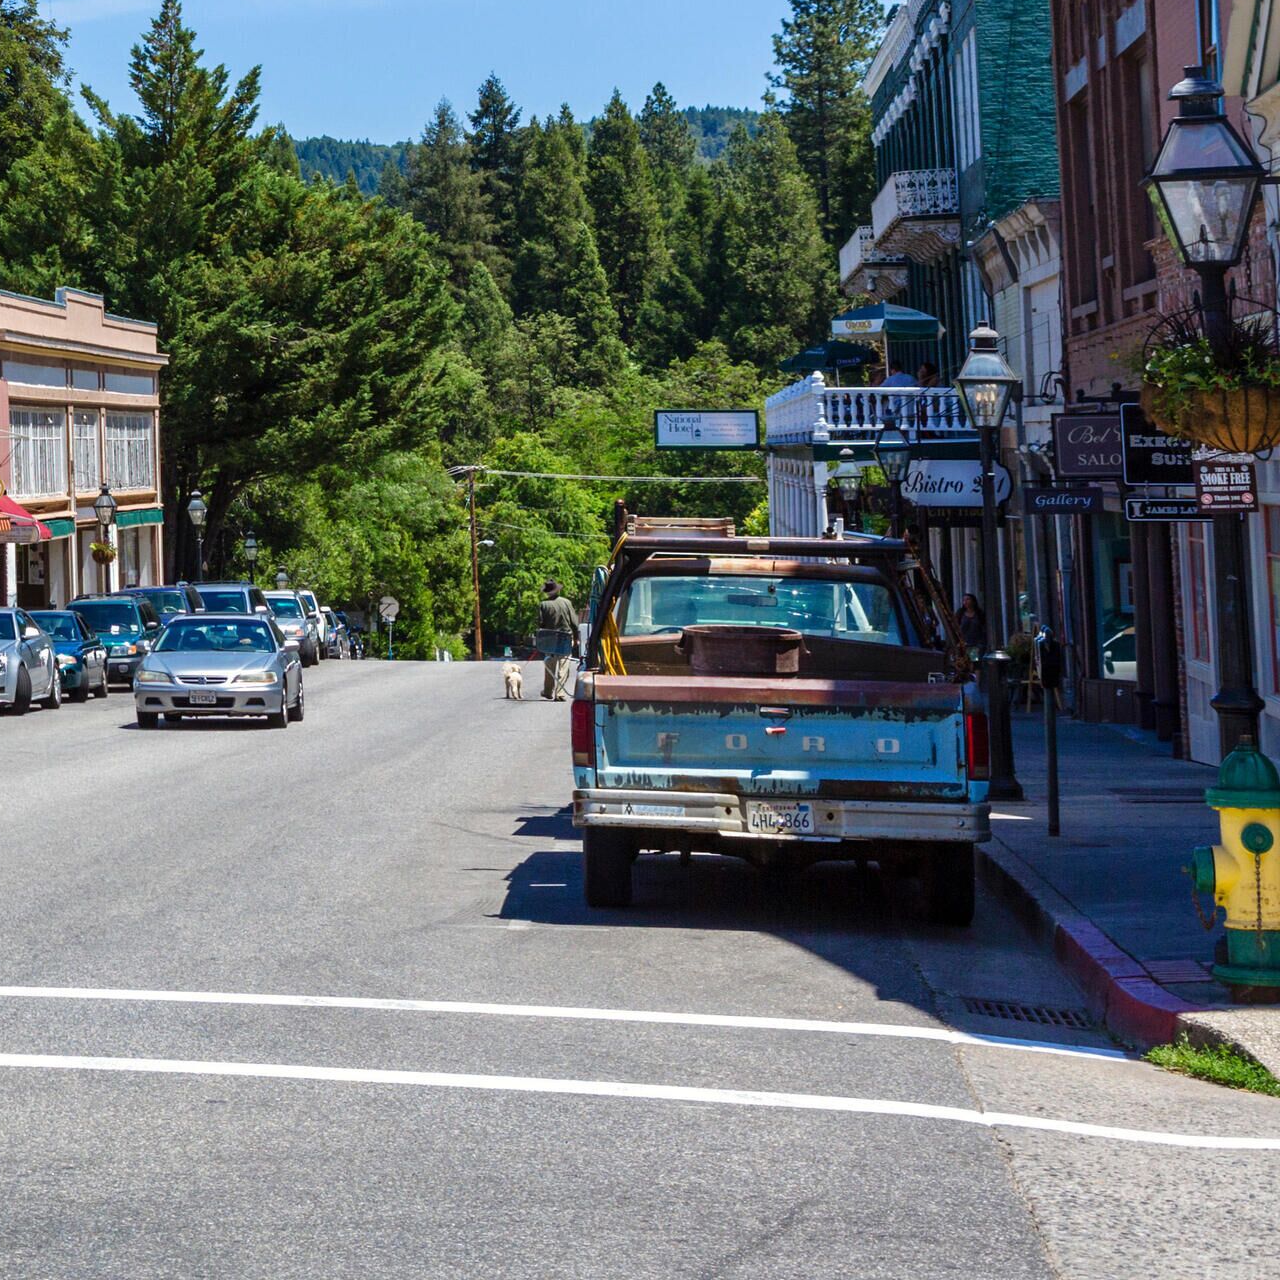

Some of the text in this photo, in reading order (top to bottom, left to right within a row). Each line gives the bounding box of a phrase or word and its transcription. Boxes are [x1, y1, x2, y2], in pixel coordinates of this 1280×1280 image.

[663, 414, 702, 424] National
[669, 423, 694, 436] Hotel
[1068, 425, 1112, 444] Bel
[1130, 435, 1191, 448] EXECU
[1078, 454, 1122, 466] SALO
[904, 471, 1005, 494] Bistro 21
[1200, 473, 1251, 485] SMOKE FREE
[1034, 494, 1092, 508] Gallery
[657, 732, 900, 755] FORD
